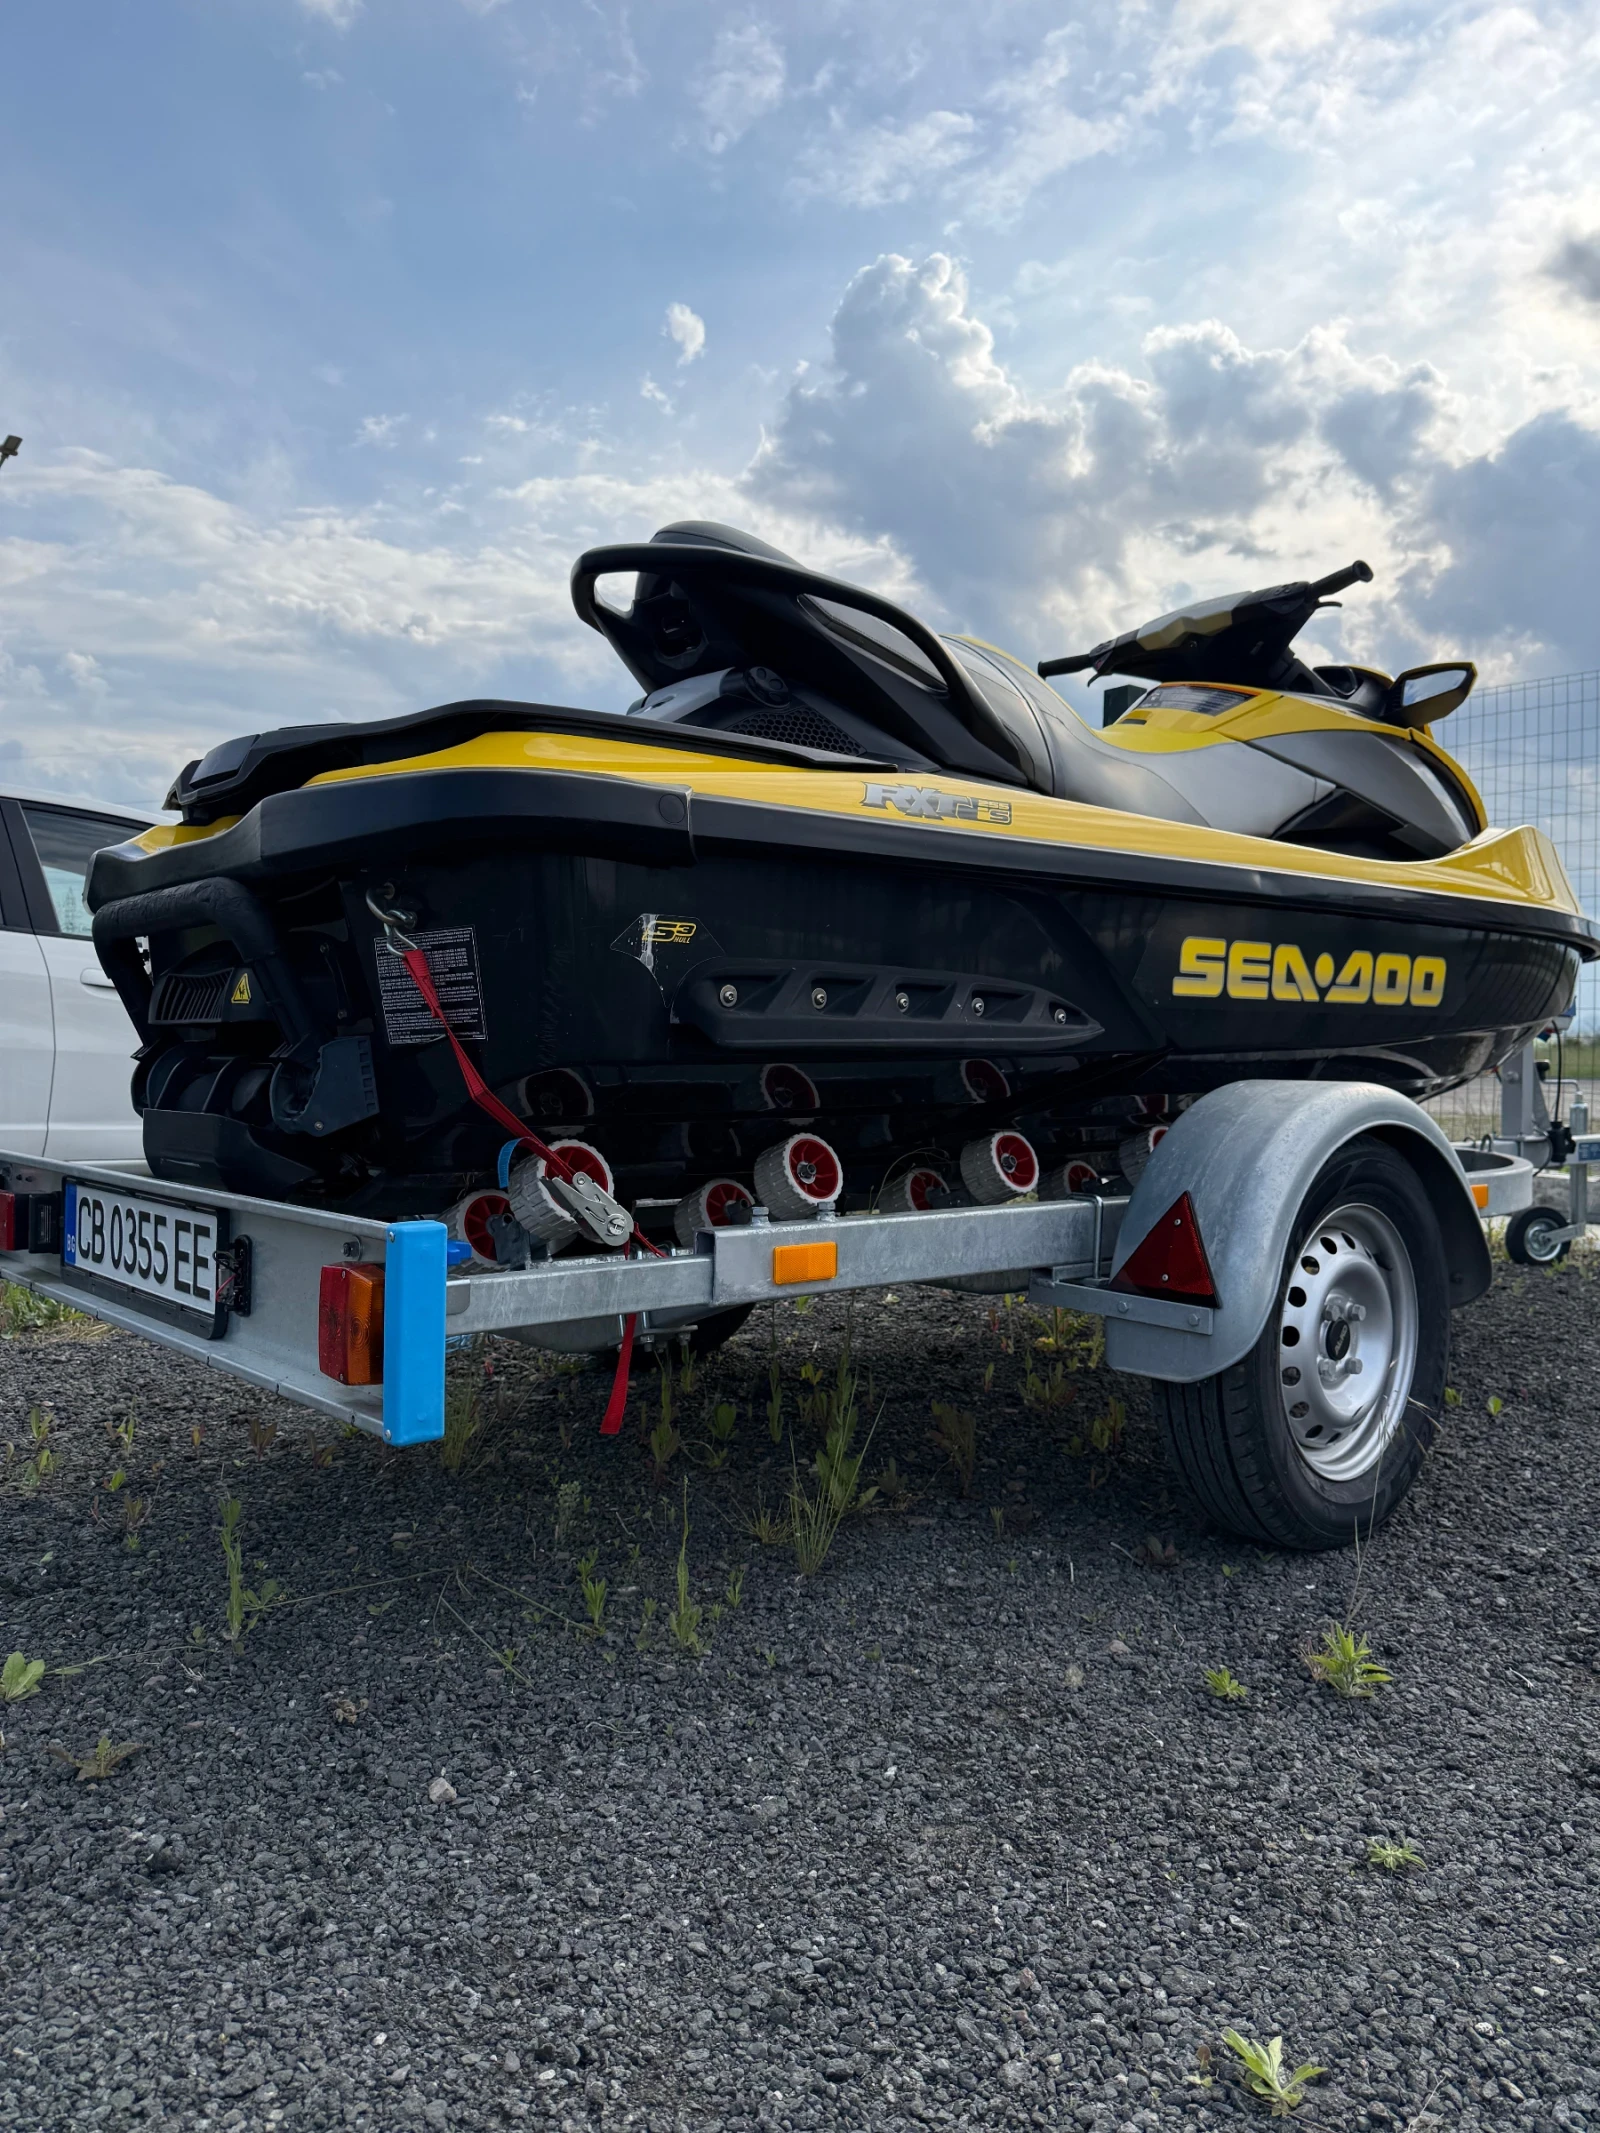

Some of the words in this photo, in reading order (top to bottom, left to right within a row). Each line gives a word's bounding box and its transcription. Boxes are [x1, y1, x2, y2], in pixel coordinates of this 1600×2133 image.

[860, 781, 973, 820] RXT
[673, 936, 691, 944] HULL
[77, 1196, 106, 1265] CB
[110, 1203, 169, 1285] 0355
[174, 1219, 211, 1302] EE
